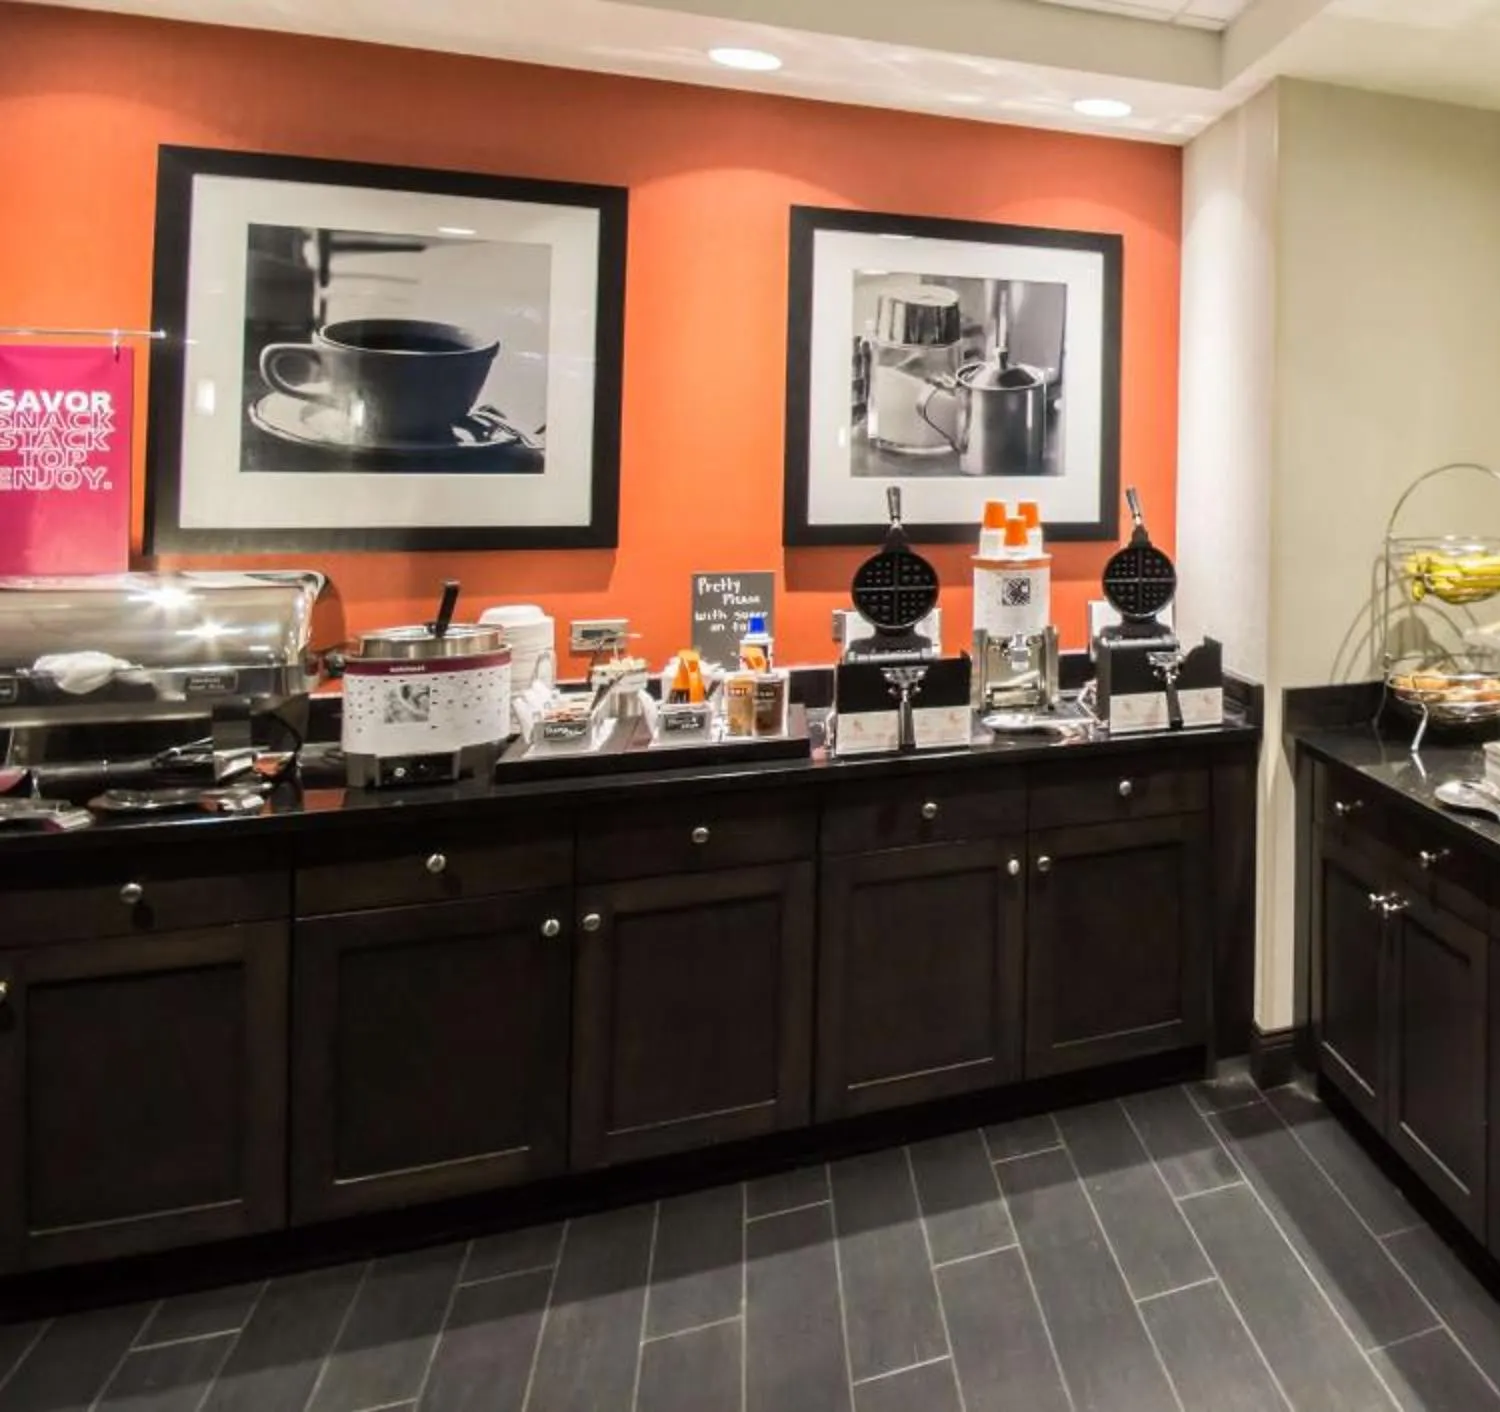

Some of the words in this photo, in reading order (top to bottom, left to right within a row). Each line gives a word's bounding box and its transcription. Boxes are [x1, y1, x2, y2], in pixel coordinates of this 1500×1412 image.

[0, 389, 112, 413] SAVOR
[0, 411, 115, 432] SNACK
[0, 429, 111, 452] STACK
[18, 447, 87, 469] TOP
